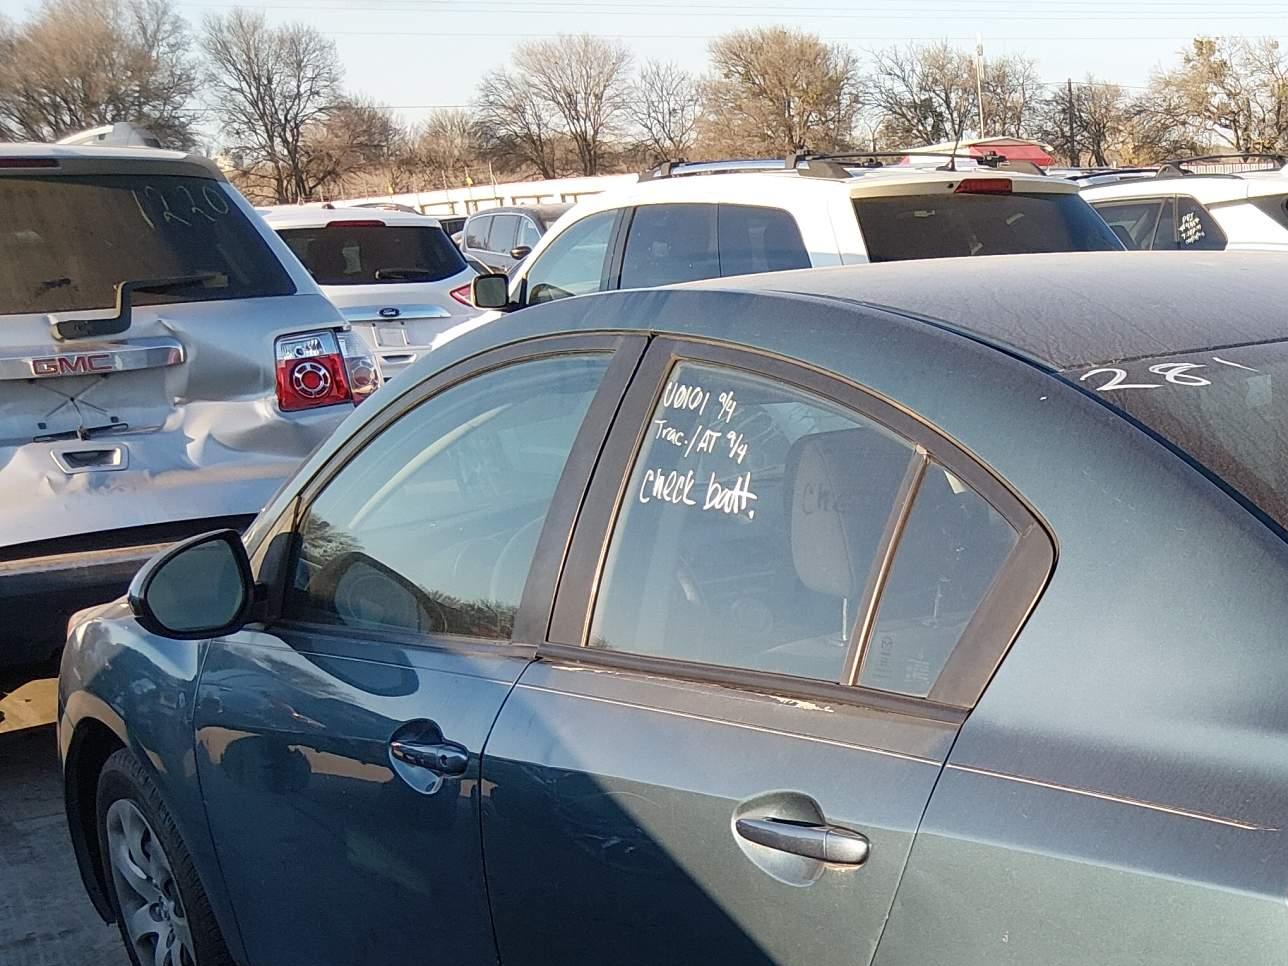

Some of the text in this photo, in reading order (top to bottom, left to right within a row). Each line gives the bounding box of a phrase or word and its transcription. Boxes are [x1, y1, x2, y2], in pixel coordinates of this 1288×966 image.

[131, 185, 229, 230] 1220
[30, 354, 113, 376] GMC
[718, 391, 737, 424] 9/4
[726, 430, 748, 465] 9/4
